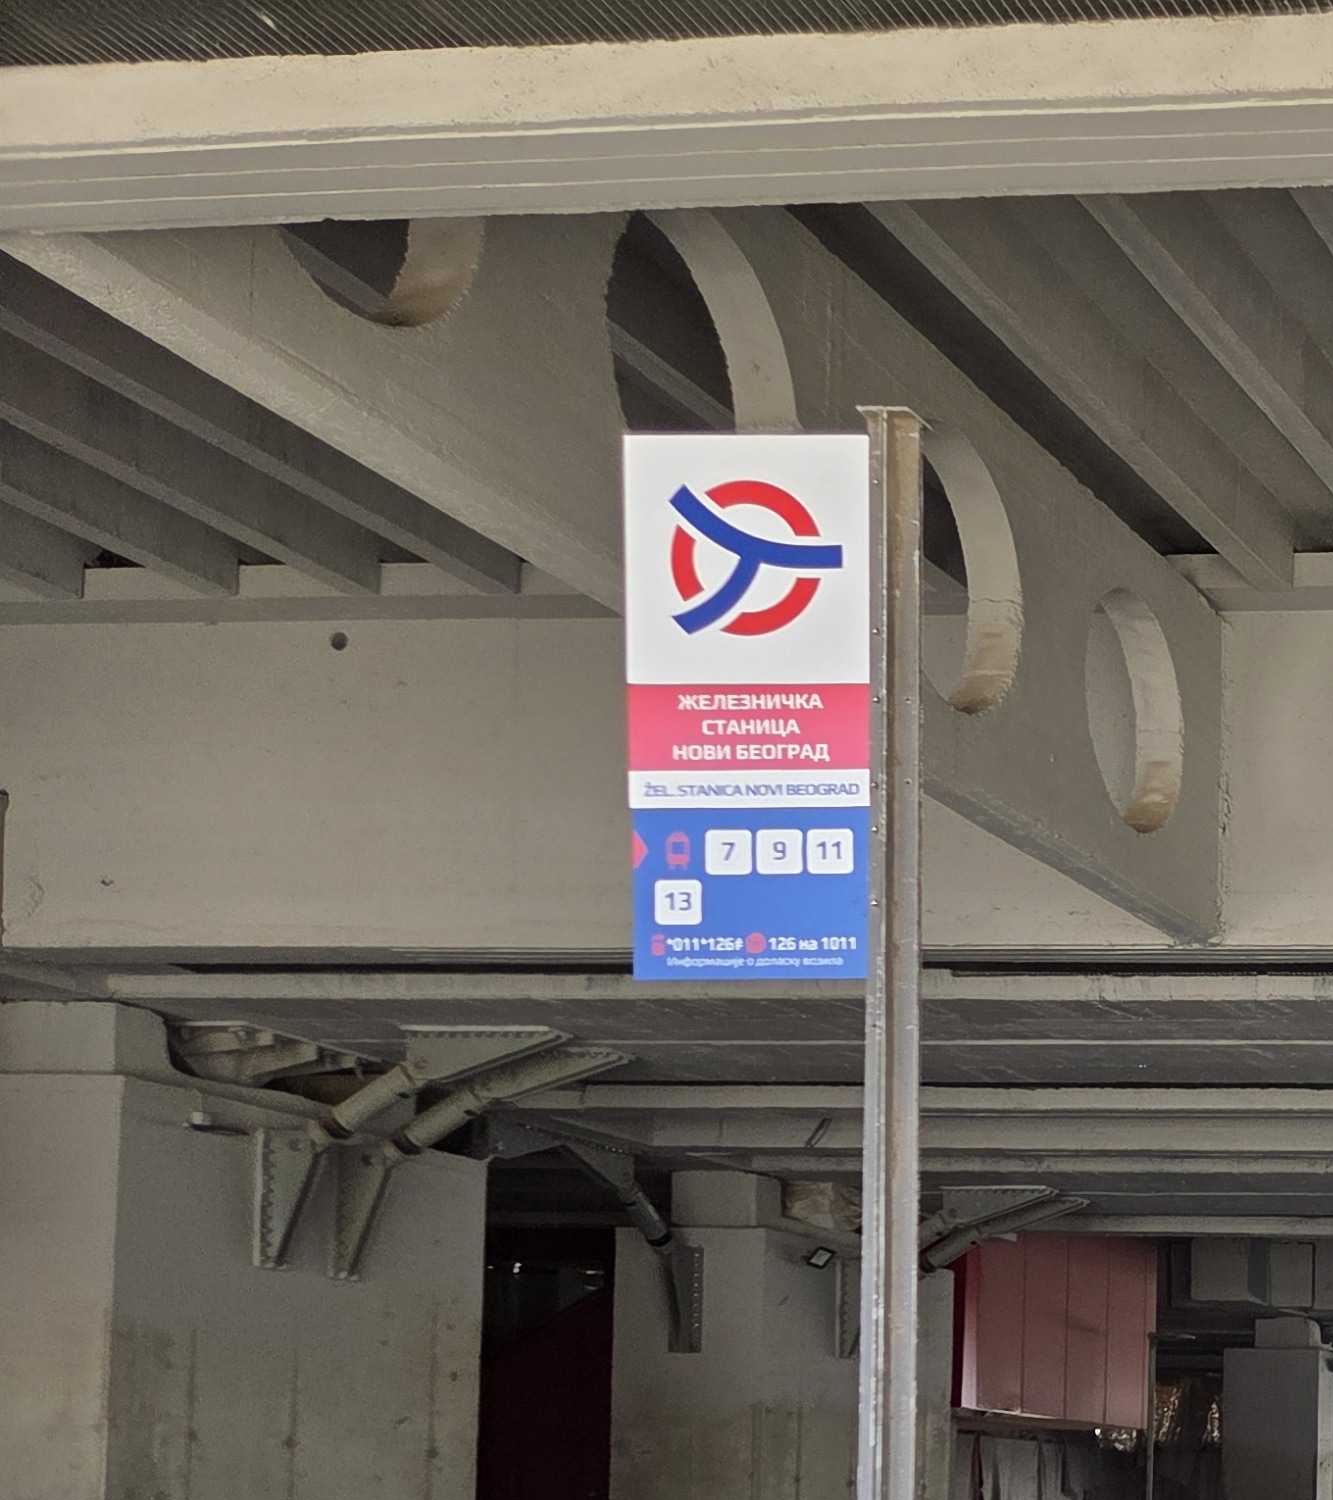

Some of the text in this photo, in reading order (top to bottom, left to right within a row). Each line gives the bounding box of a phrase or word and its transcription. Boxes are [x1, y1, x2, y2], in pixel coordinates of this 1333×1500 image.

[677, 693, 824, 711] ЖЕЛЕЗНИЧКА
[701, 718, 801, 737] СТАНИЦА
[672, 743, 830, 762] НОВИ БЕОГРАД
[677, 784, 743, 797] STANICA
[745, 784, 783, 796] NOVI
[786, 783, 860, 796] BEOGRAD
[721, 841, 843, 861] 7 9 11
[664, 892, 692, 911] 13
[768, 937, 797, 950] 126
[820, 936, 857, 950] 1011
